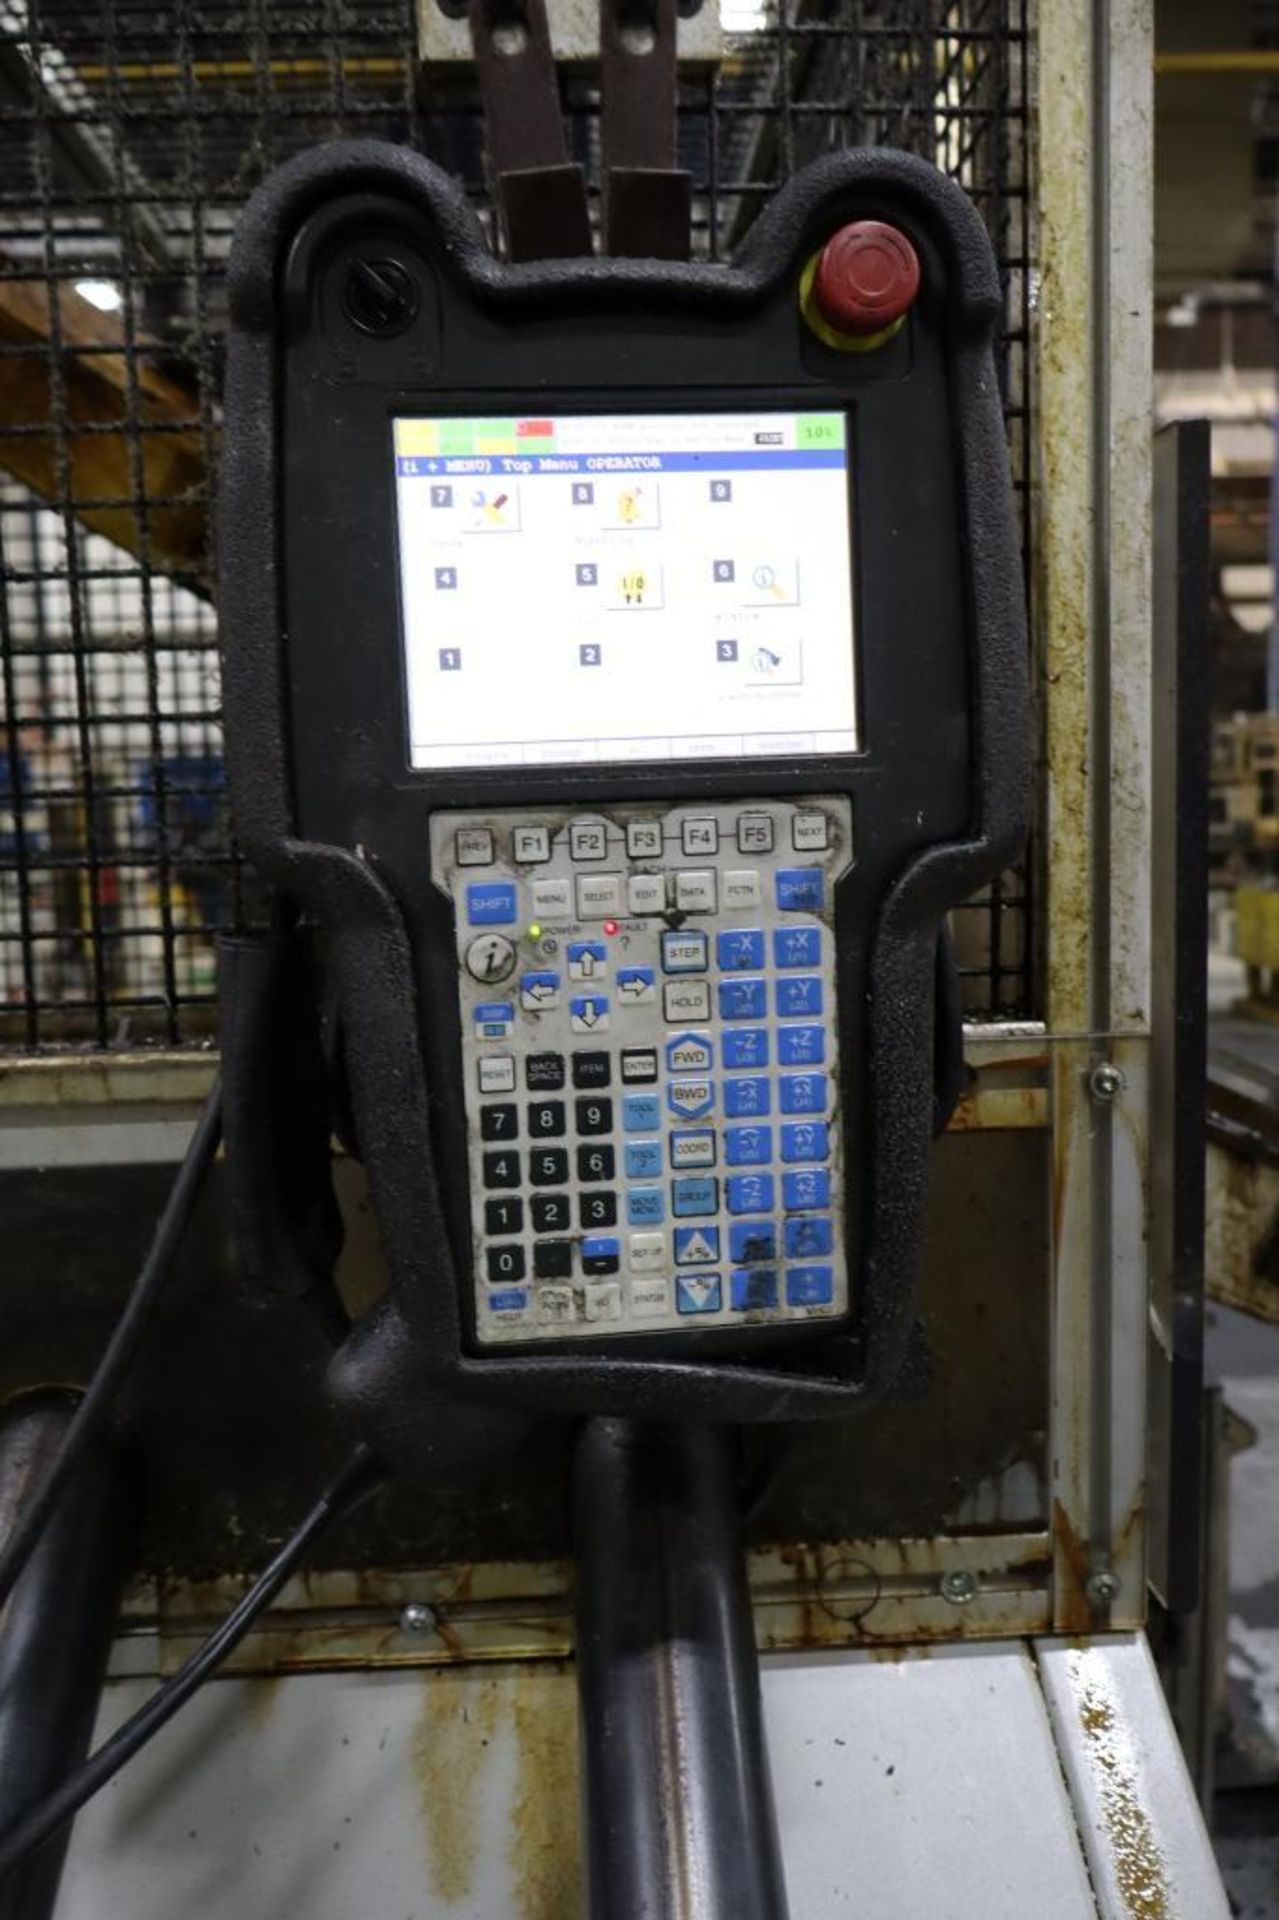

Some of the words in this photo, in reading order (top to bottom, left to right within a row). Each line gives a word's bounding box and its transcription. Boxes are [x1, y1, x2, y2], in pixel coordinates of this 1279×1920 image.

[445, 459, 491, 474] MENU)
[503, 459, 533, 474] Top
[539, 457, 580, 472] Menu
[586, 456, 662, 472] OPERATOR
[633, 830, 656, 848] F3
[689, 828, 711, 846] F4
[744, 825, 767, 844] F5
[796, 826, 823, 838] NEXT
[521, 836, 544, 853] F1
[576, 833, 600, 851] F2
[584, 890, 615, 902] SELECT
[635, 889, 658, 900] EDIT
[681, 887, 705, 898] DATA
[728, 884, 754, 895] FCTN
[779, 882, 817, 897] SHIFT
[471, 896, 511, 912] SHIFT
[536, 893, 566, 905] MENU
[543, 924, 581, 936] POWER
[728, 934, 753, 952] -X
[785, 931, 809, 948] +X
[669, 946, 701, 958] STEP
[733, 983, 756, 1000] -Y
[788, 980, 811, 997] +Y
[671, 995, 703, 1007] HOLD
[735, 1032, 757, 1049] -Z
[789, 1029, 812, 1046] +Z
[673, 1049, 705, 1063] FWD
[480, 1068, 511, 1080] RESET
[529, 1062, 559, 1071] BACK
[580, 1063, 605, 1073] ITEM
[624, 1060, 655, 1072] ENTER
[528, 1071, 561, 1081] SPACE
[674, 1087, 707, 1100] BWD
[587, 1106, 601, 1125] 9
[628, 1102, 655, 1114] TOOL
[491, 1112, 506, 1131] 7
[540, 1109, 553, 1128] 8
[589, 1153, 603, 1172] 6
[631, 1149, 657, 1160] TOOL
[494, 1160, 509, 1178] 4
[541, 1156, 556, 1175] 5
[497, 1207, 508, 1225] 1
[544, 1203, 559, 1221] 2
[591, 1200, 606, 1219] 3
[499, 1253, 514, 1272] 0
